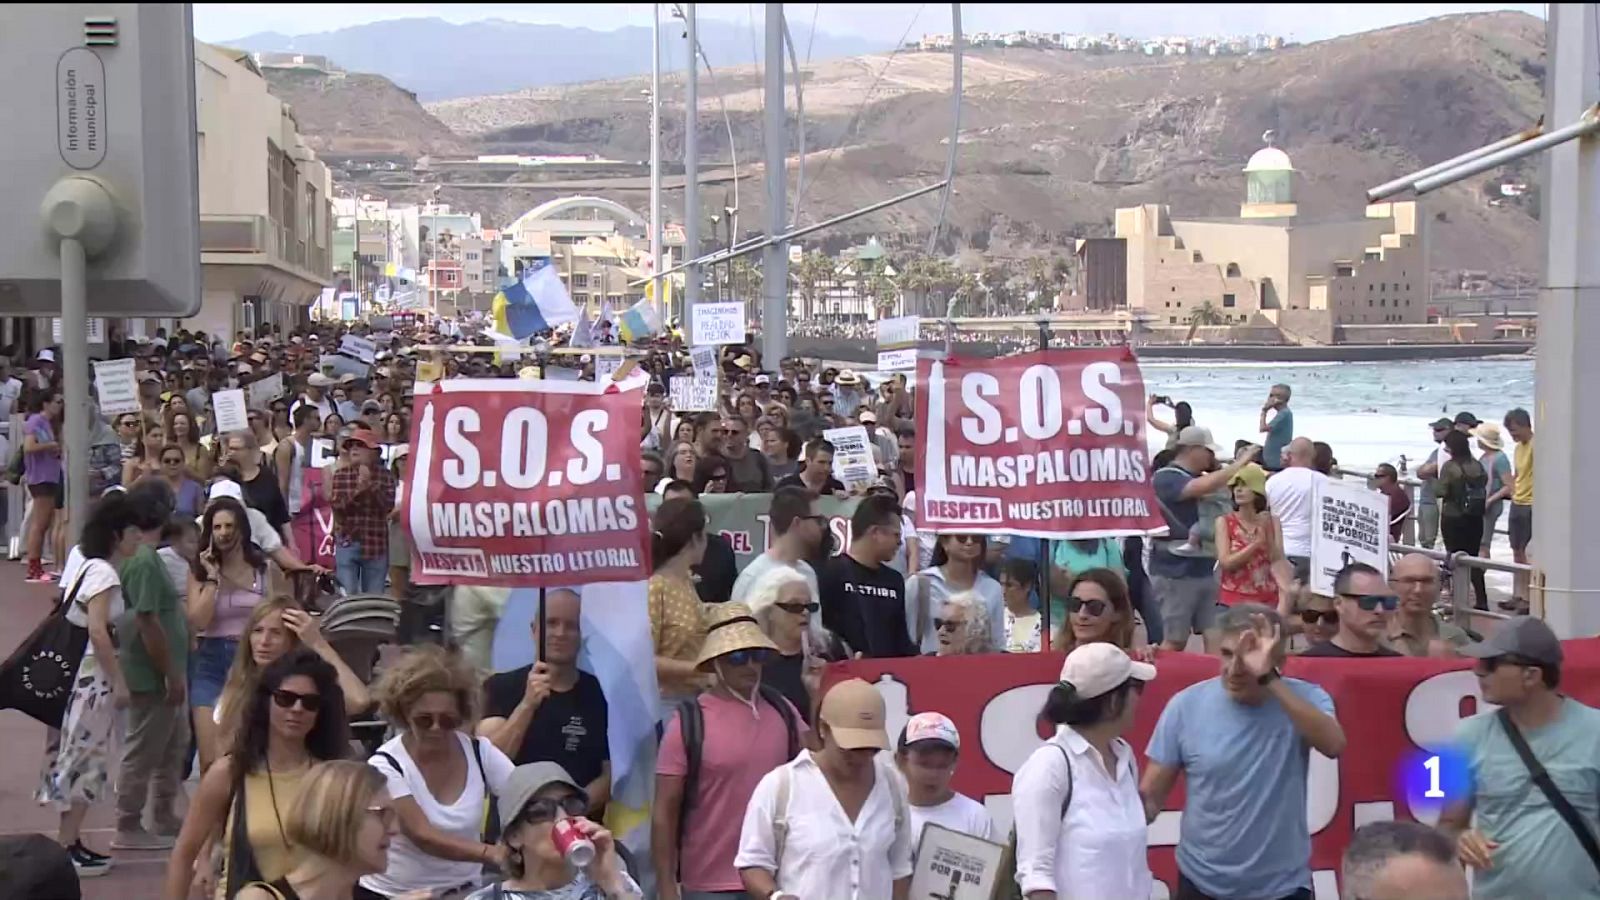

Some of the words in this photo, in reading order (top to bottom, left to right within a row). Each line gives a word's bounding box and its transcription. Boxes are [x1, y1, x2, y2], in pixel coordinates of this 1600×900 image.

[66, 69, 78, 151] información
[84, 84, 97, 151] municipal
[961, 361, 1135, 446] S.O.S.
[442, 405, 621, 490] S.O.S.
[950, 447, 1146, 488] MASPALOMAS
[431, 494, 638, 538] MASPALOMAS
[927, 500, 1000, 520] RESPETA
[1008, 499, 1084, 521] NUESTRO
[1088, 498, 1150, 517] LITORAL
[1322, 520, 1335, 533] DE
[1338, 525, 1380, 547] POBREZA
[490, 553, 564, 574] NUESTRO
[569, 548, 639, 570] LITORAL
[32, 650, 71, 677] LABOUR
[930, 861, 952, 877] POR
